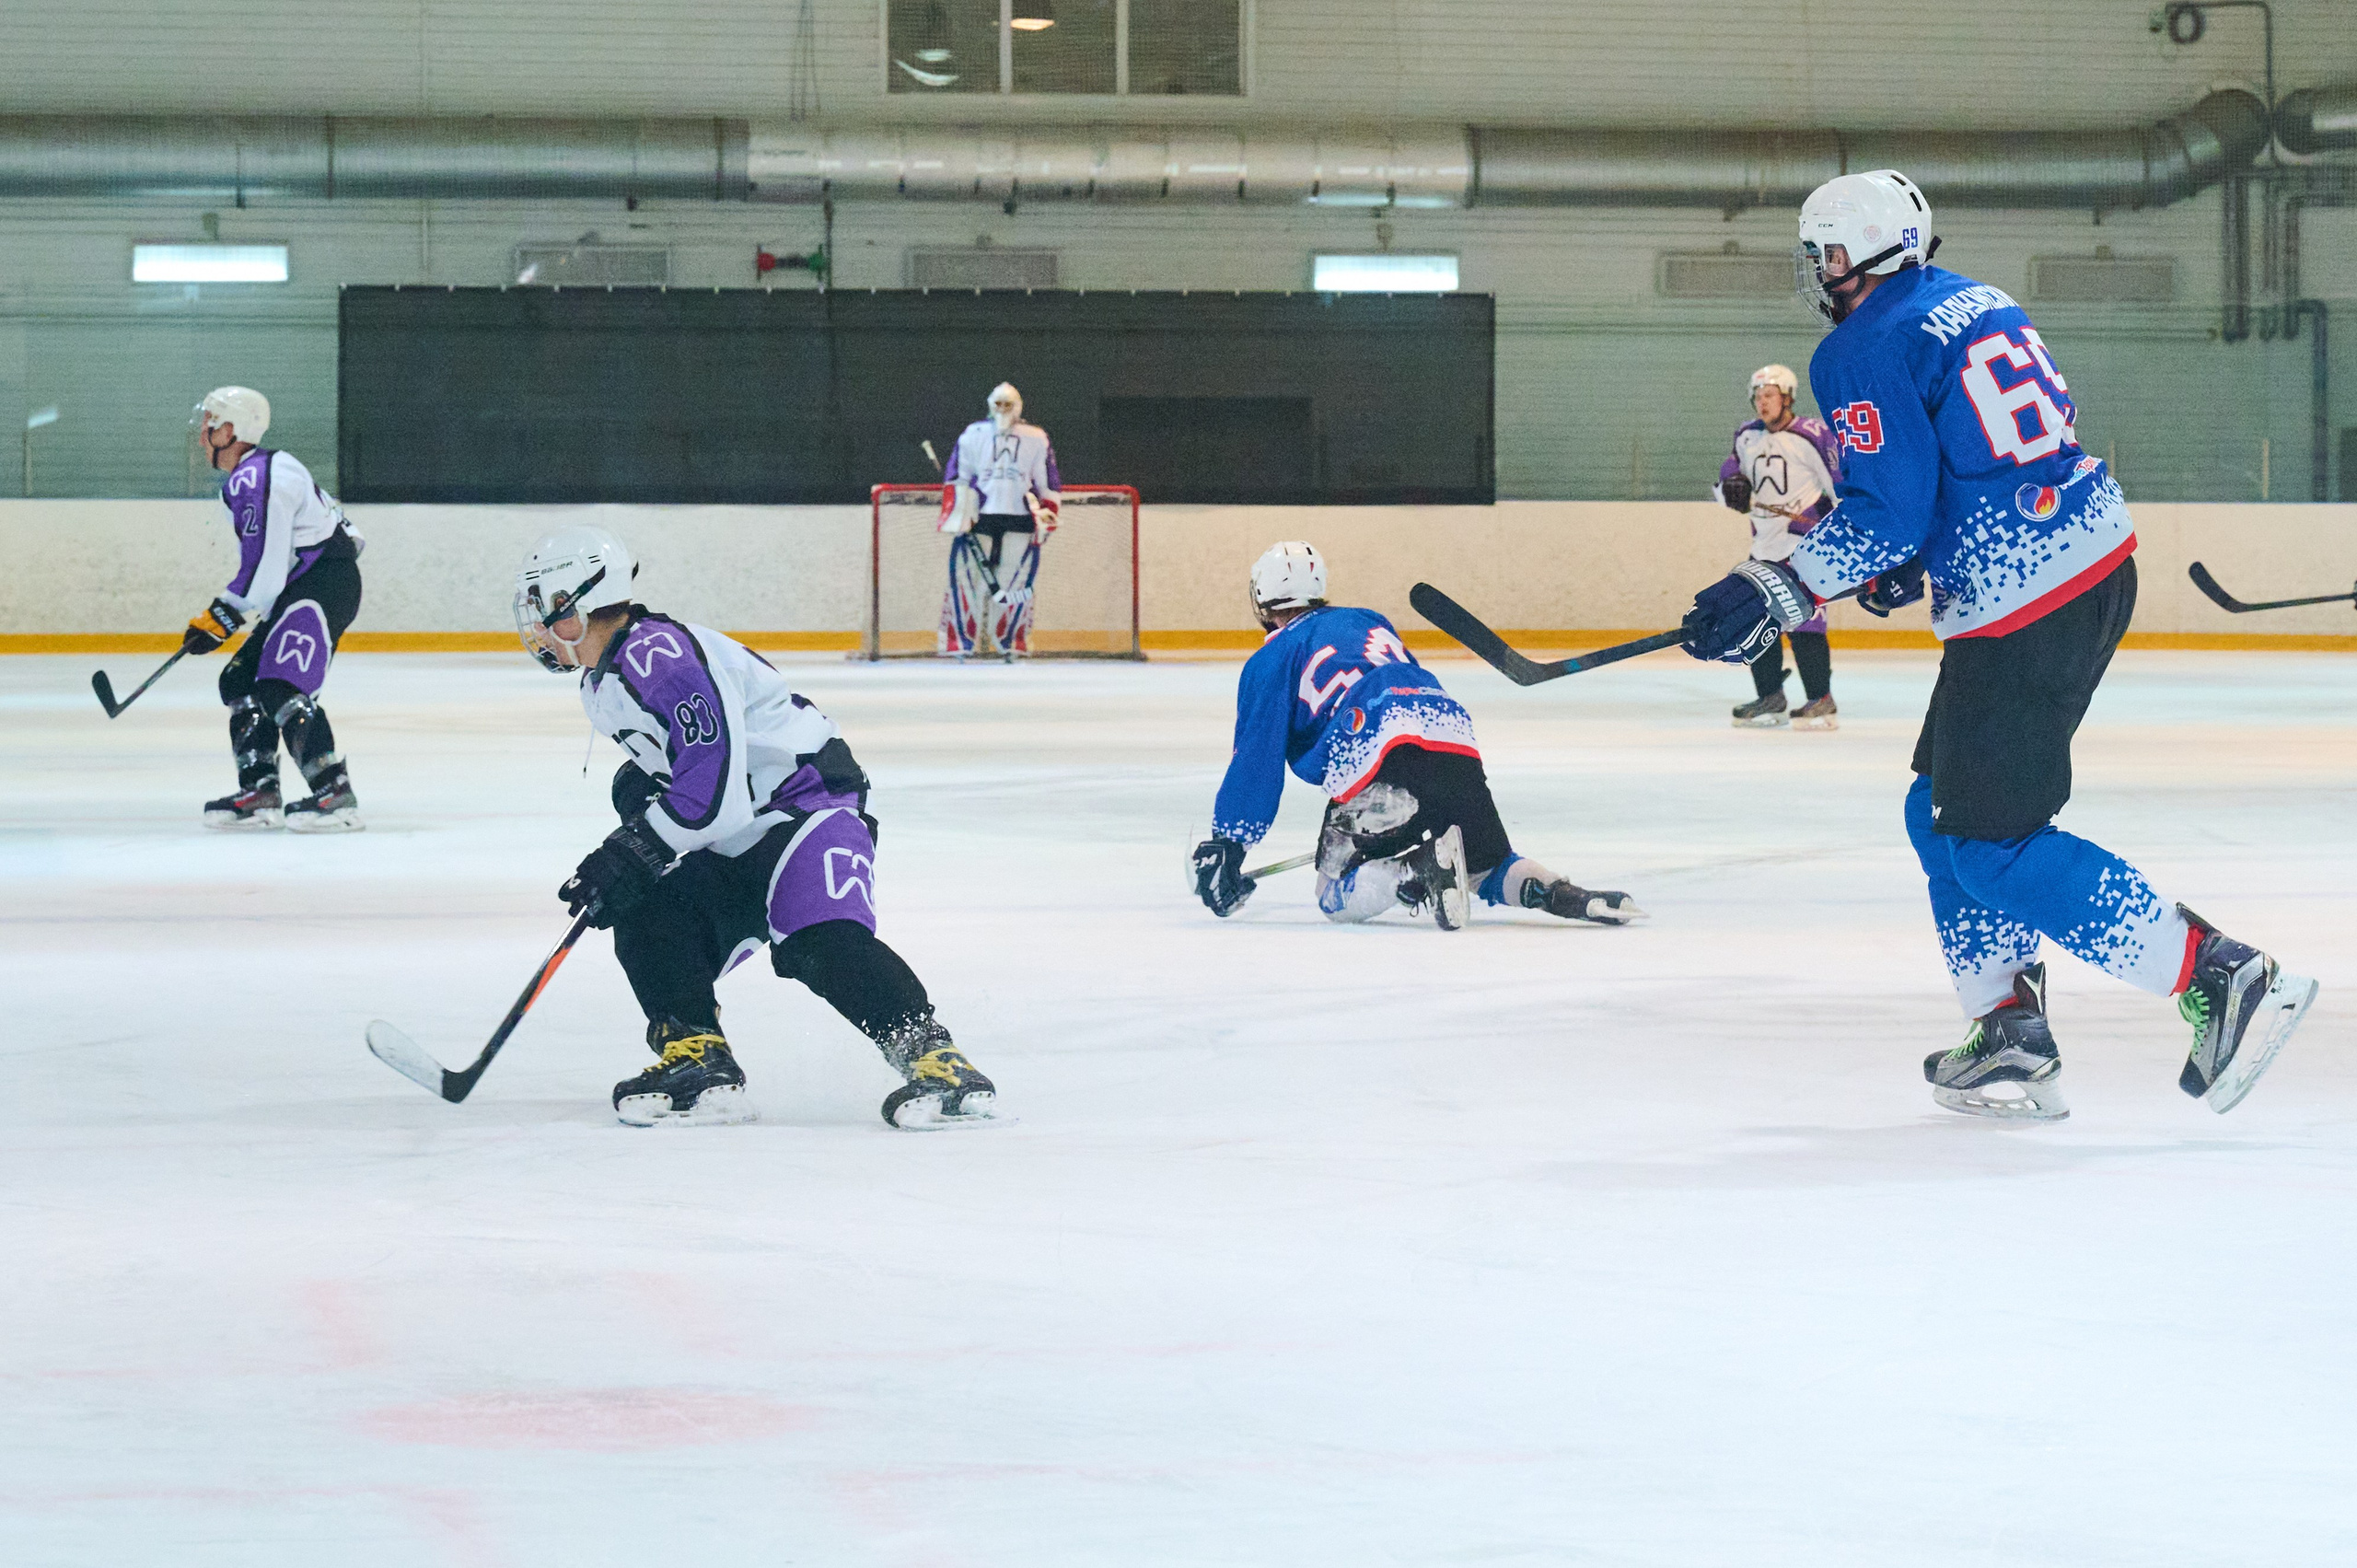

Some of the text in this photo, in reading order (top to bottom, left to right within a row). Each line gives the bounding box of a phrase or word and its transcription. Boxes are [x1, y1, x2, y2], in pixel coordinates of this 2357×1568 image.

[1902, 227, 1918, 249] 69
[243, 503, 259, 537] 2
[1736, 561, 1805, 626] WARRIOR
[674, 691, 720, 747] 83
